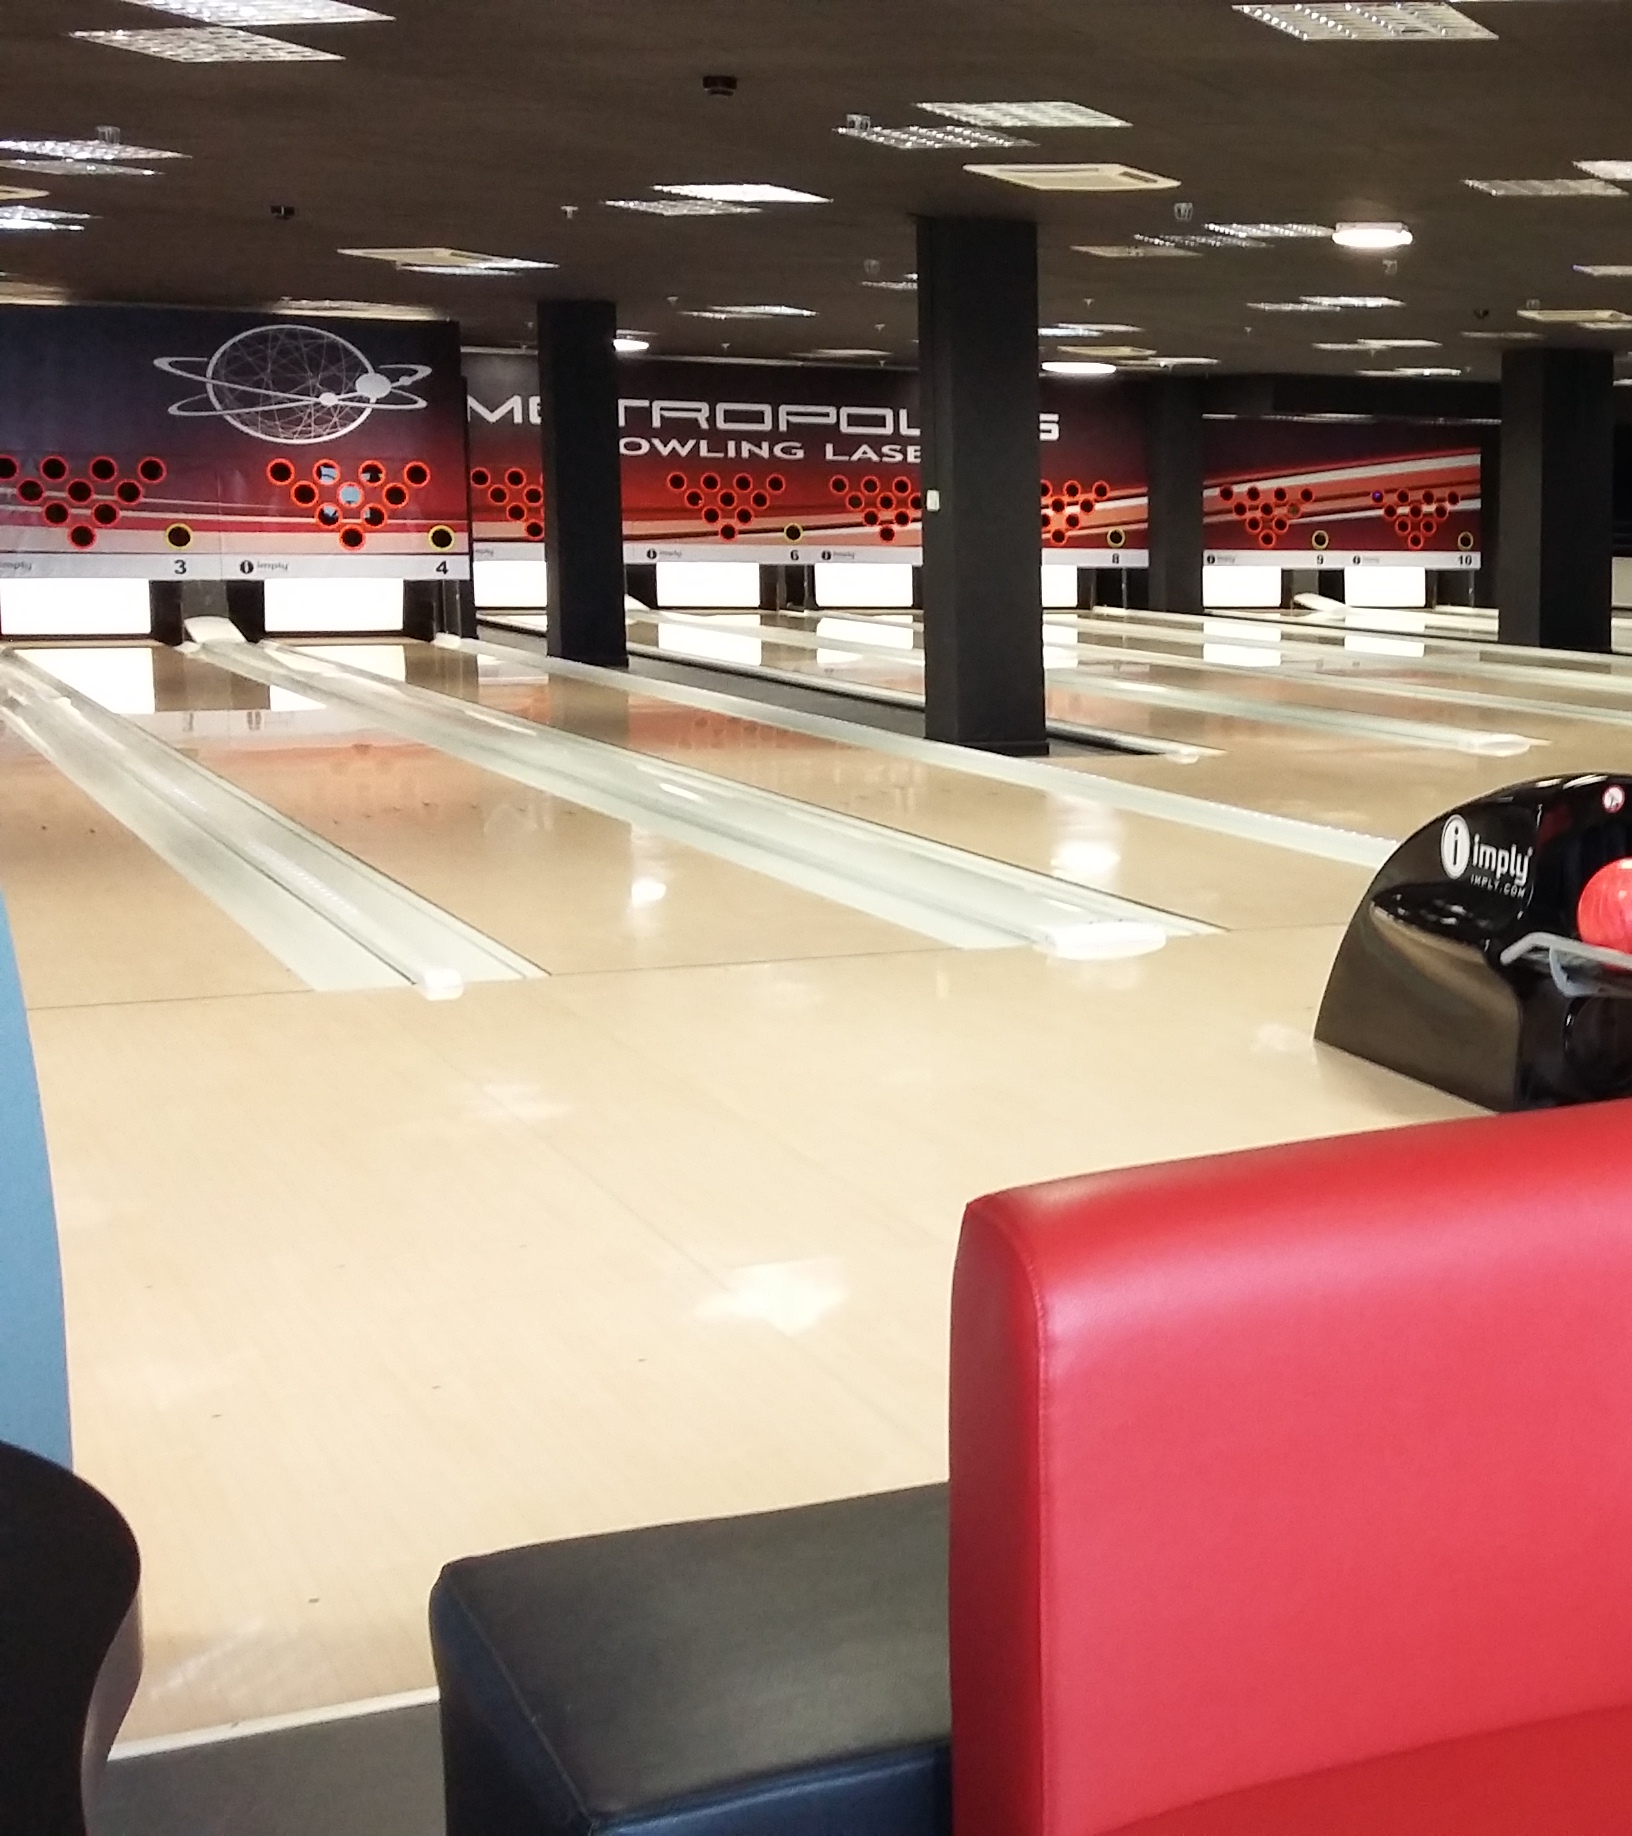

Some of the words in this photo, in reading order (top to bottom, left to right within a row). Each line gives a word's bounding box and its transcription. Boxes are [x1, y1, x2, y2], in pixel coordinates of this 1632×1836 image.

[618, 437, 805, 461] OWLING
[825, 443, 921, 464] LASE
[790, 549, 800, 561] 6
[1111, 553, 1120, 564] 8
[1316, 553, 1325, 566] 9
[1457, 554, 1472, 566] 10
[174, 559, 187, 574] 3
[435, 561, 449, 574] 4
[1472, 833, 1531, 887] imply
[1470, 874, 1526, 899] IMPLY.COM
